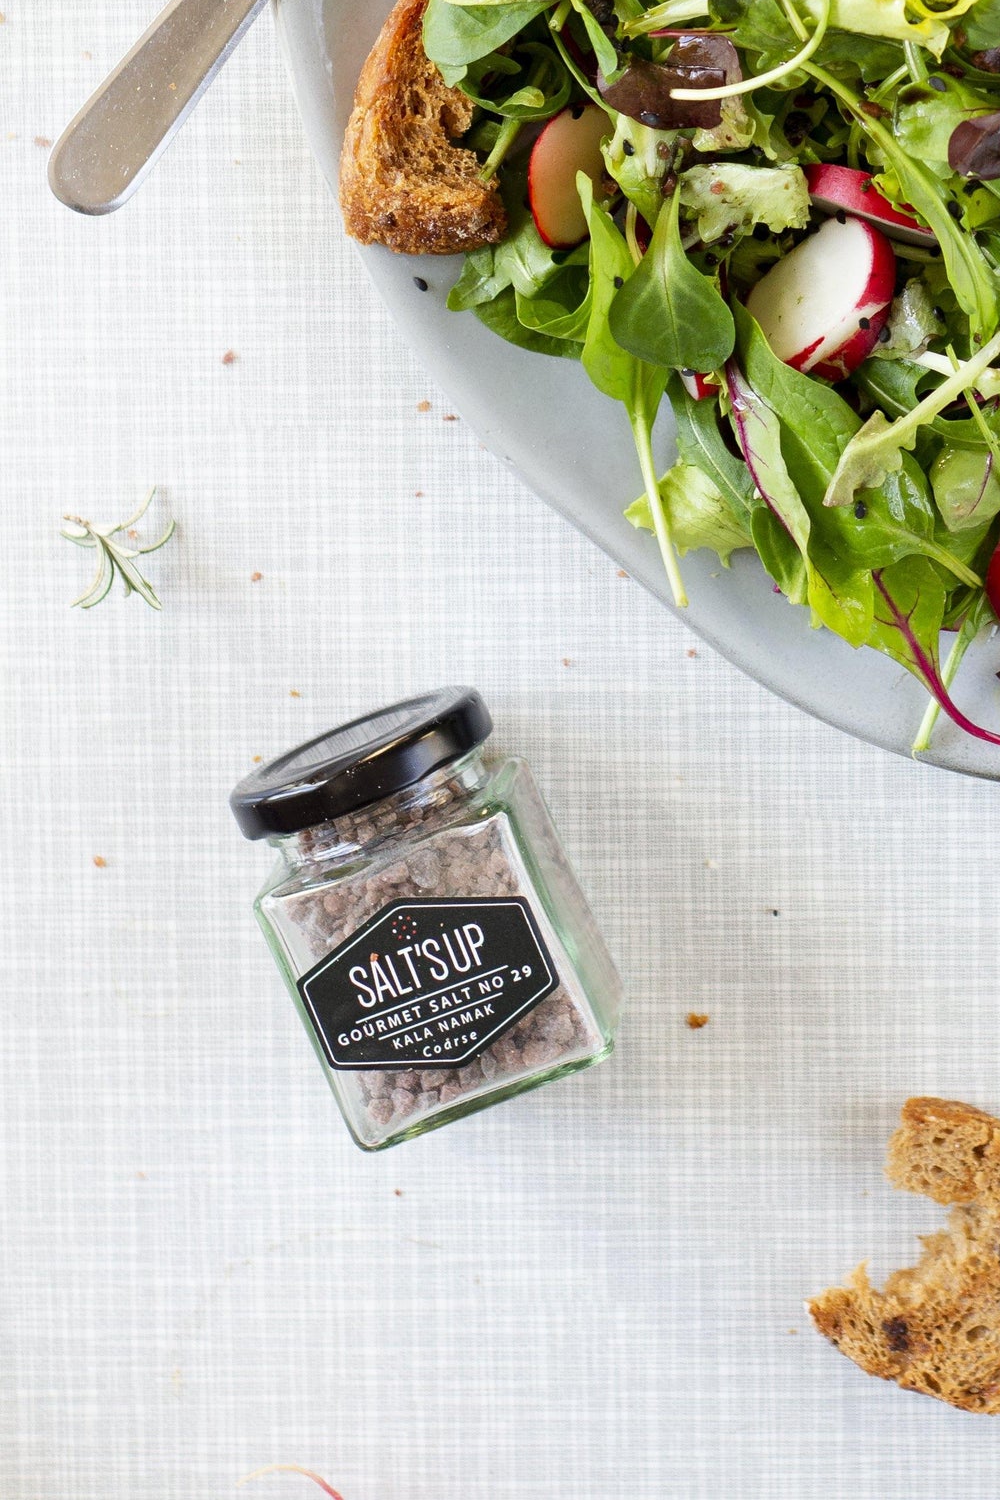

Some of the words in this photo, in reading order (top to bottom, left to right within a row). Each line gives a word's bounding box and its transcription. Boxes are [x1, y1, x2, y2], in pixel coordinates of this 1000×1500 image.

[337, 1006, 422, 1046] GOURMET
[429, 987, 471, 1012] SALT
[479, 976, 504, 994] NO
[512, 964, 532, 983] 29
[392, 1028, 433, 1050] KALA
[438, 1003, 495, 1033] NAMAK
[423, 1031, 478, 1058] Coarse
